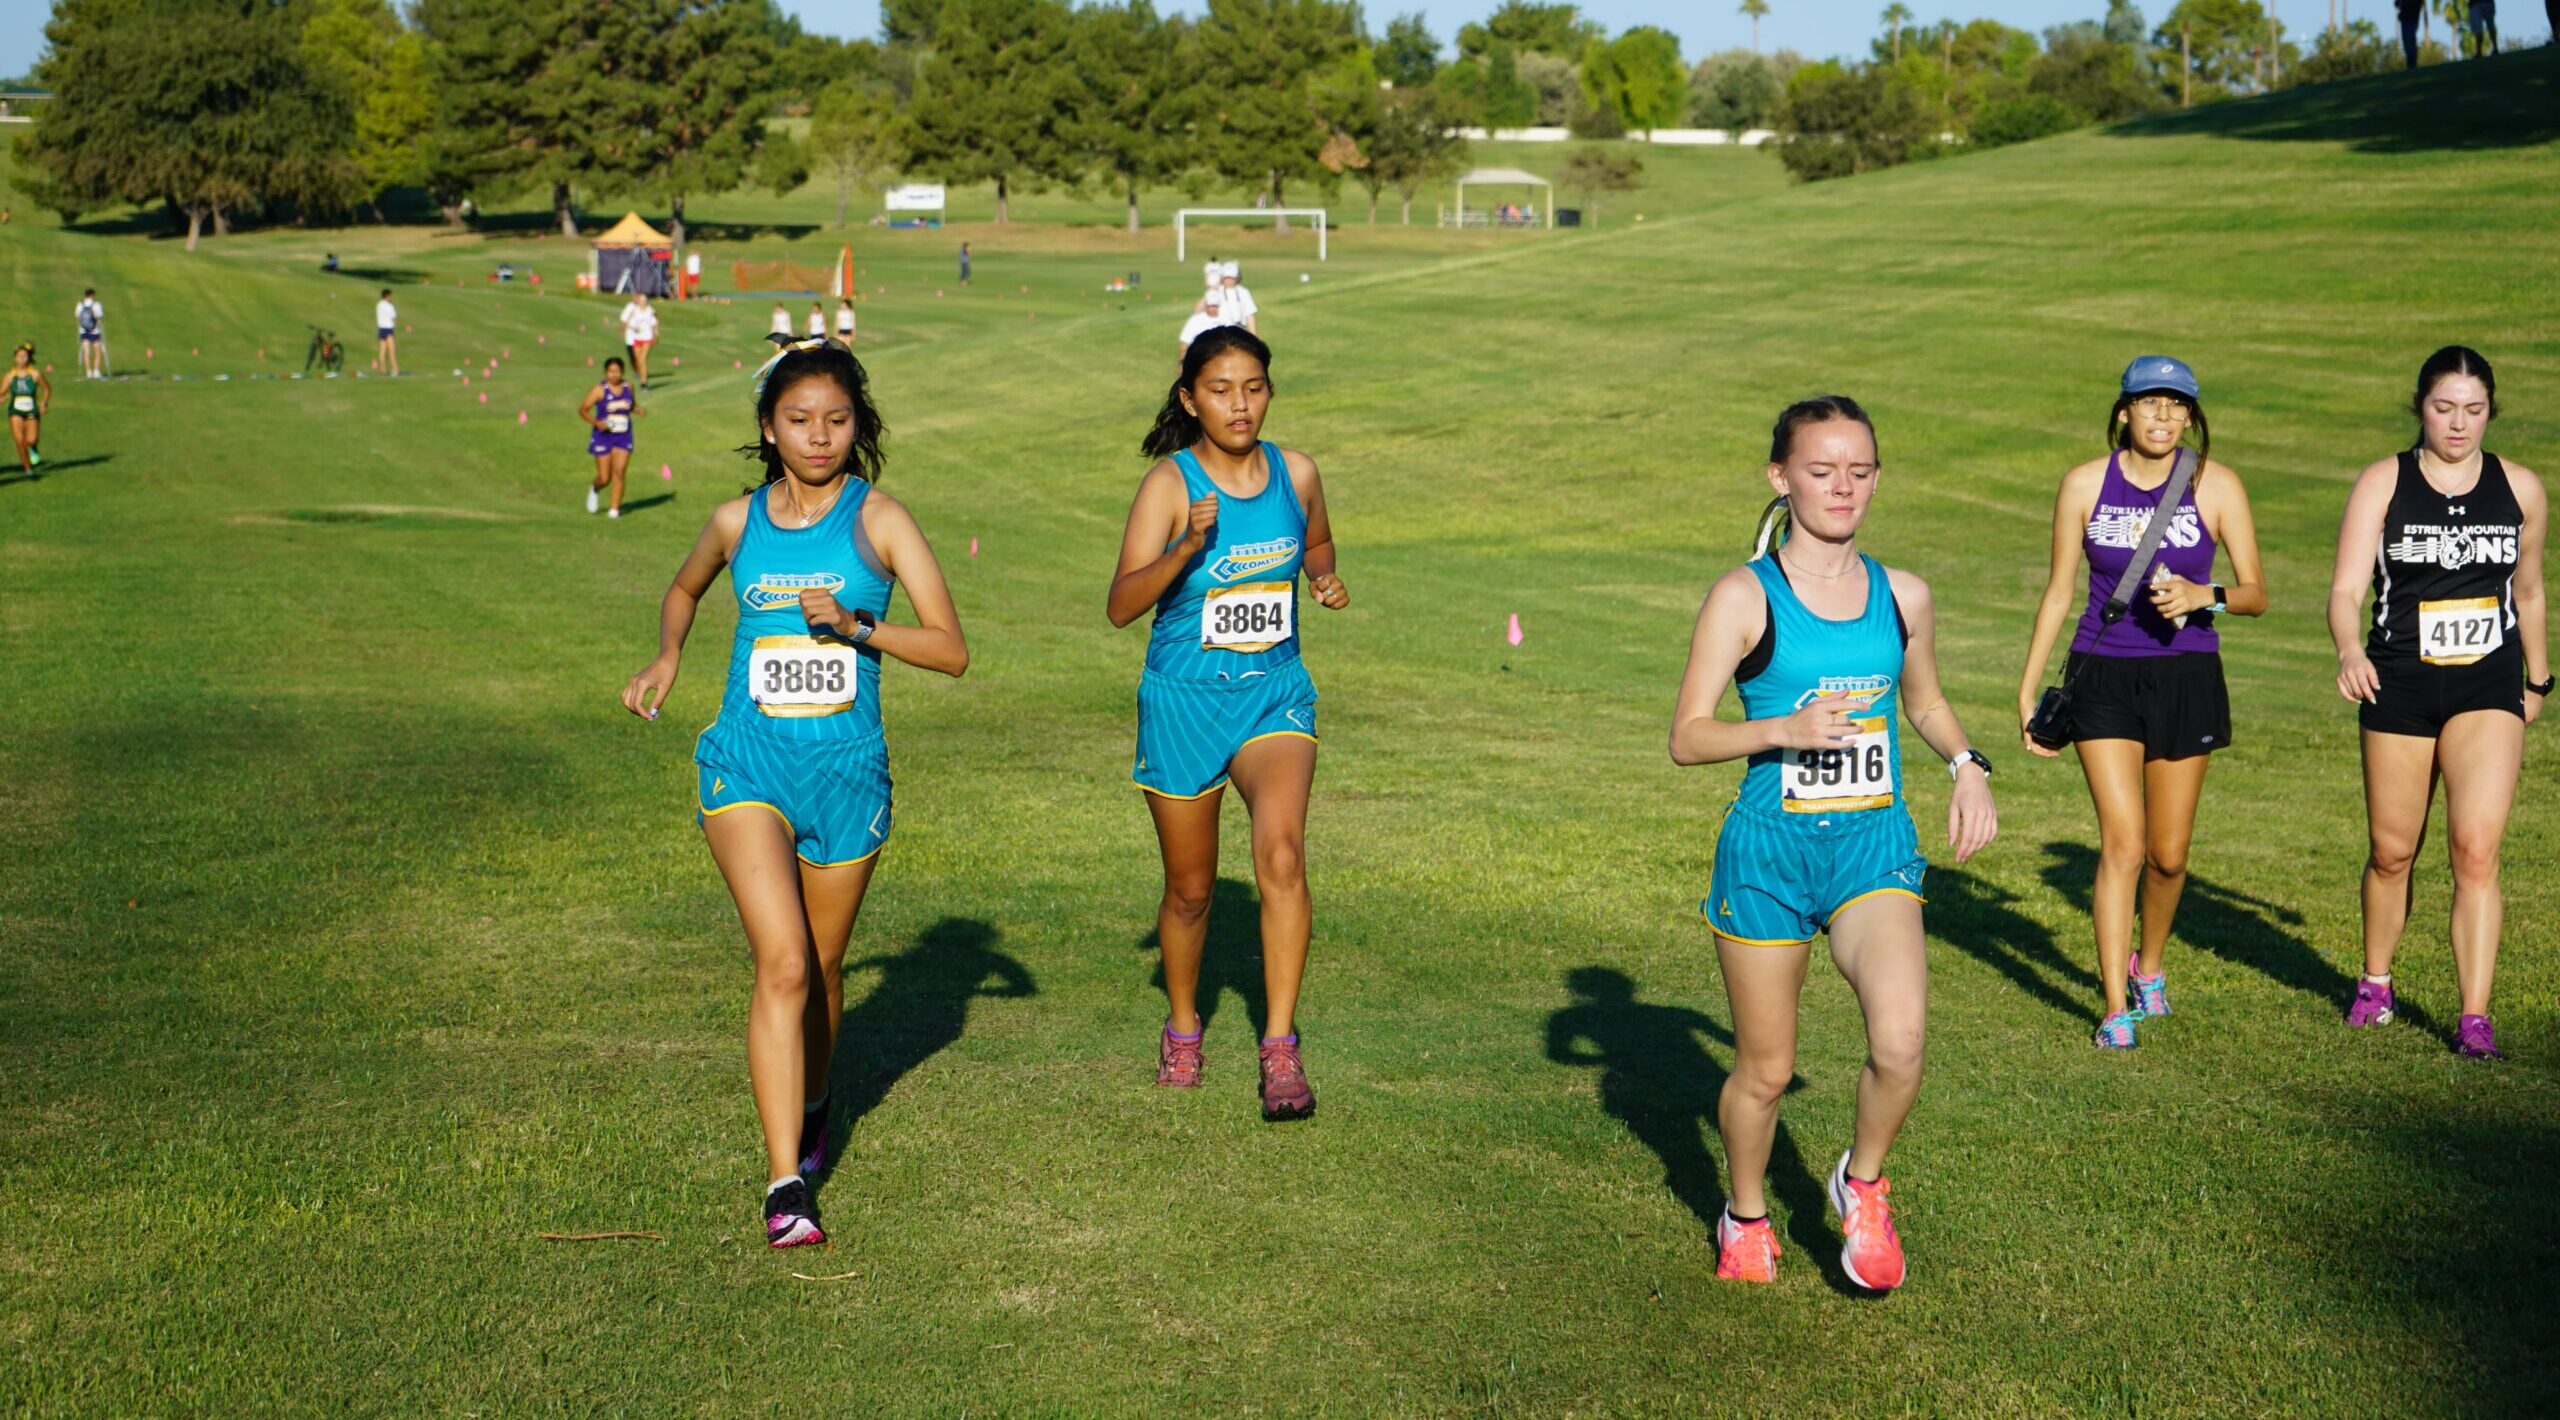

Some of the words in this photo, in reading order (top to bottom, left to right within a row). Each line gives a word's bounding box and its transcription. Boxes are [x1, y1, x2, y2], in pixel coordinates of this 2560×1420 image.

[2100, 504, 2144, 516] ESTRELLA
[2144, 505, 2196, 517] MTAIN
[2403, 524, 2459, 535] ESTRELLA
[2462, 525, 2516, 536] MOUNTAIN
[774, 593, 800, 601] COM
[1215, 602, 1284, 634] 3864
[2431, 617, 2494, 647] 4127
[763, 659, 846, 693] 3863
[1797, 744, 1884, 787] 3916
